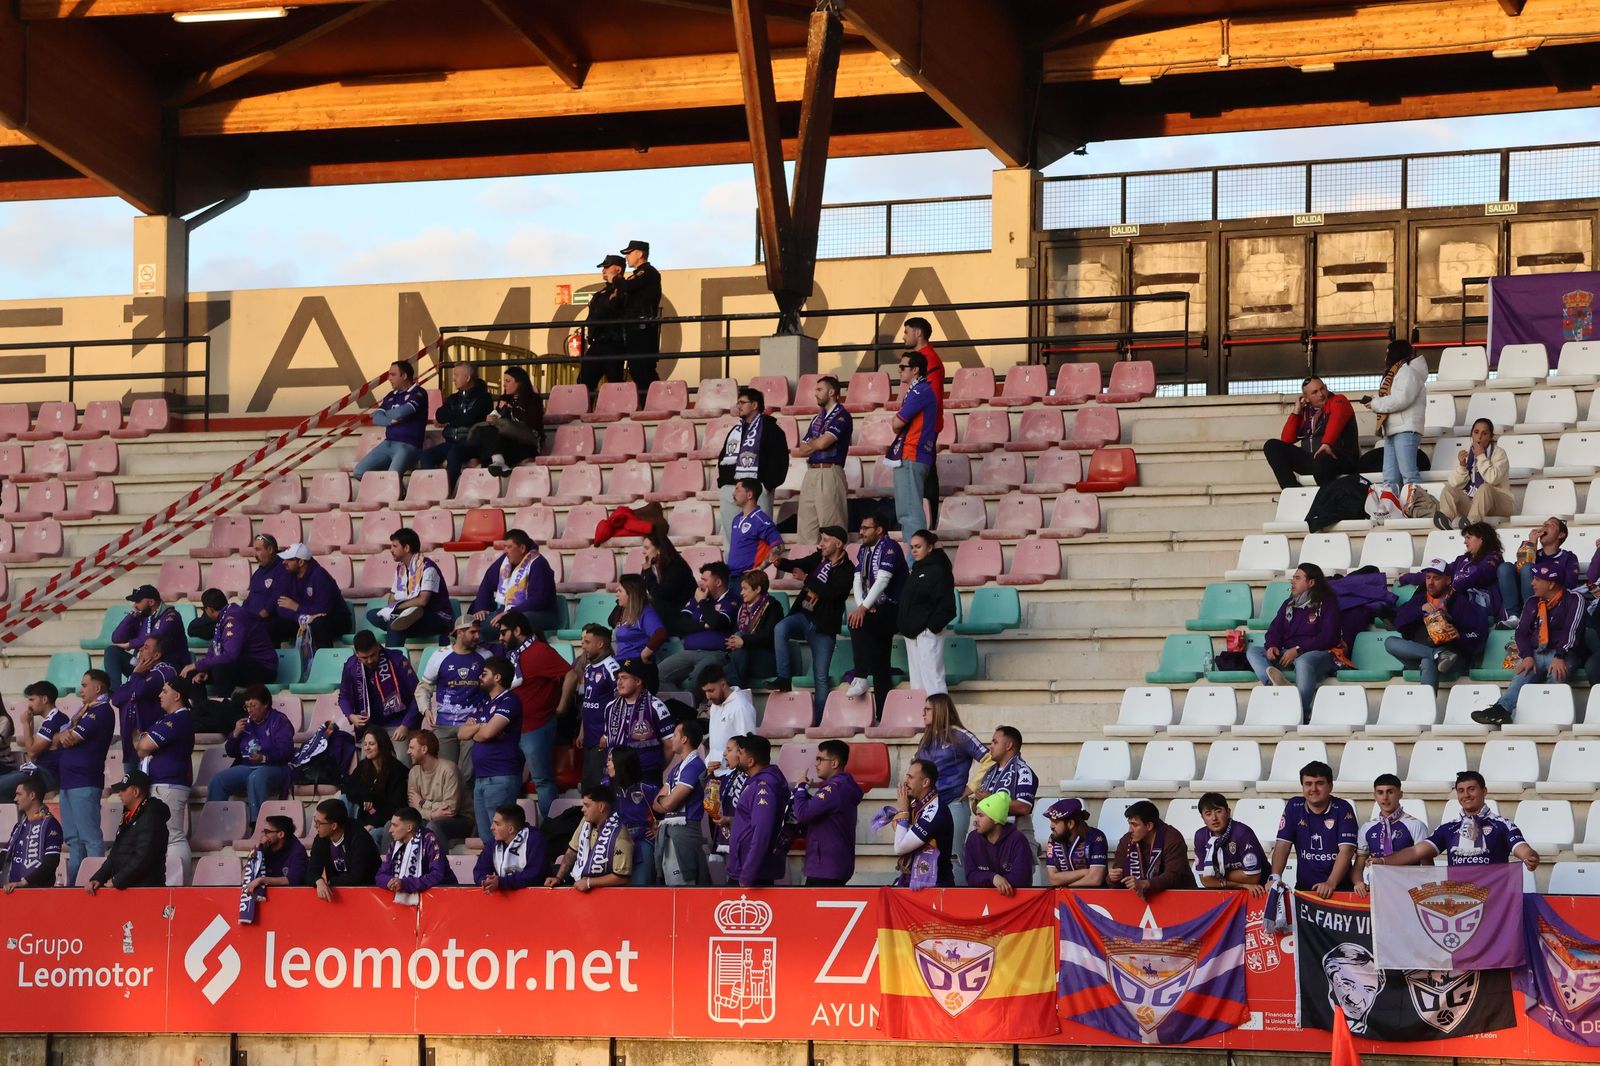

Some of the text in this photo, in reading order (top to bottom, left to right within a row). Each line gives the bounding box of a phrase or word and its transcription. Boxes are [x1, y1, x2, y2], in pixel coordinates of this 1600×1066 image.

[1488, 203, 1515, 213] SALIDA
[1296, 214, 1322, 224] SALIDA
[1112, 225, 1137, 235] SALIDA
[1451, 855, 1490, 865] Hercesa
[1300, 903, 1315, 923] EL
[1315, 910, 1352, 934] FARY
[18, 933, 83, 961] Grupo
[264, 931, 639, 992] leomotor.net
[18, 961, 154, 987] Leomotor
